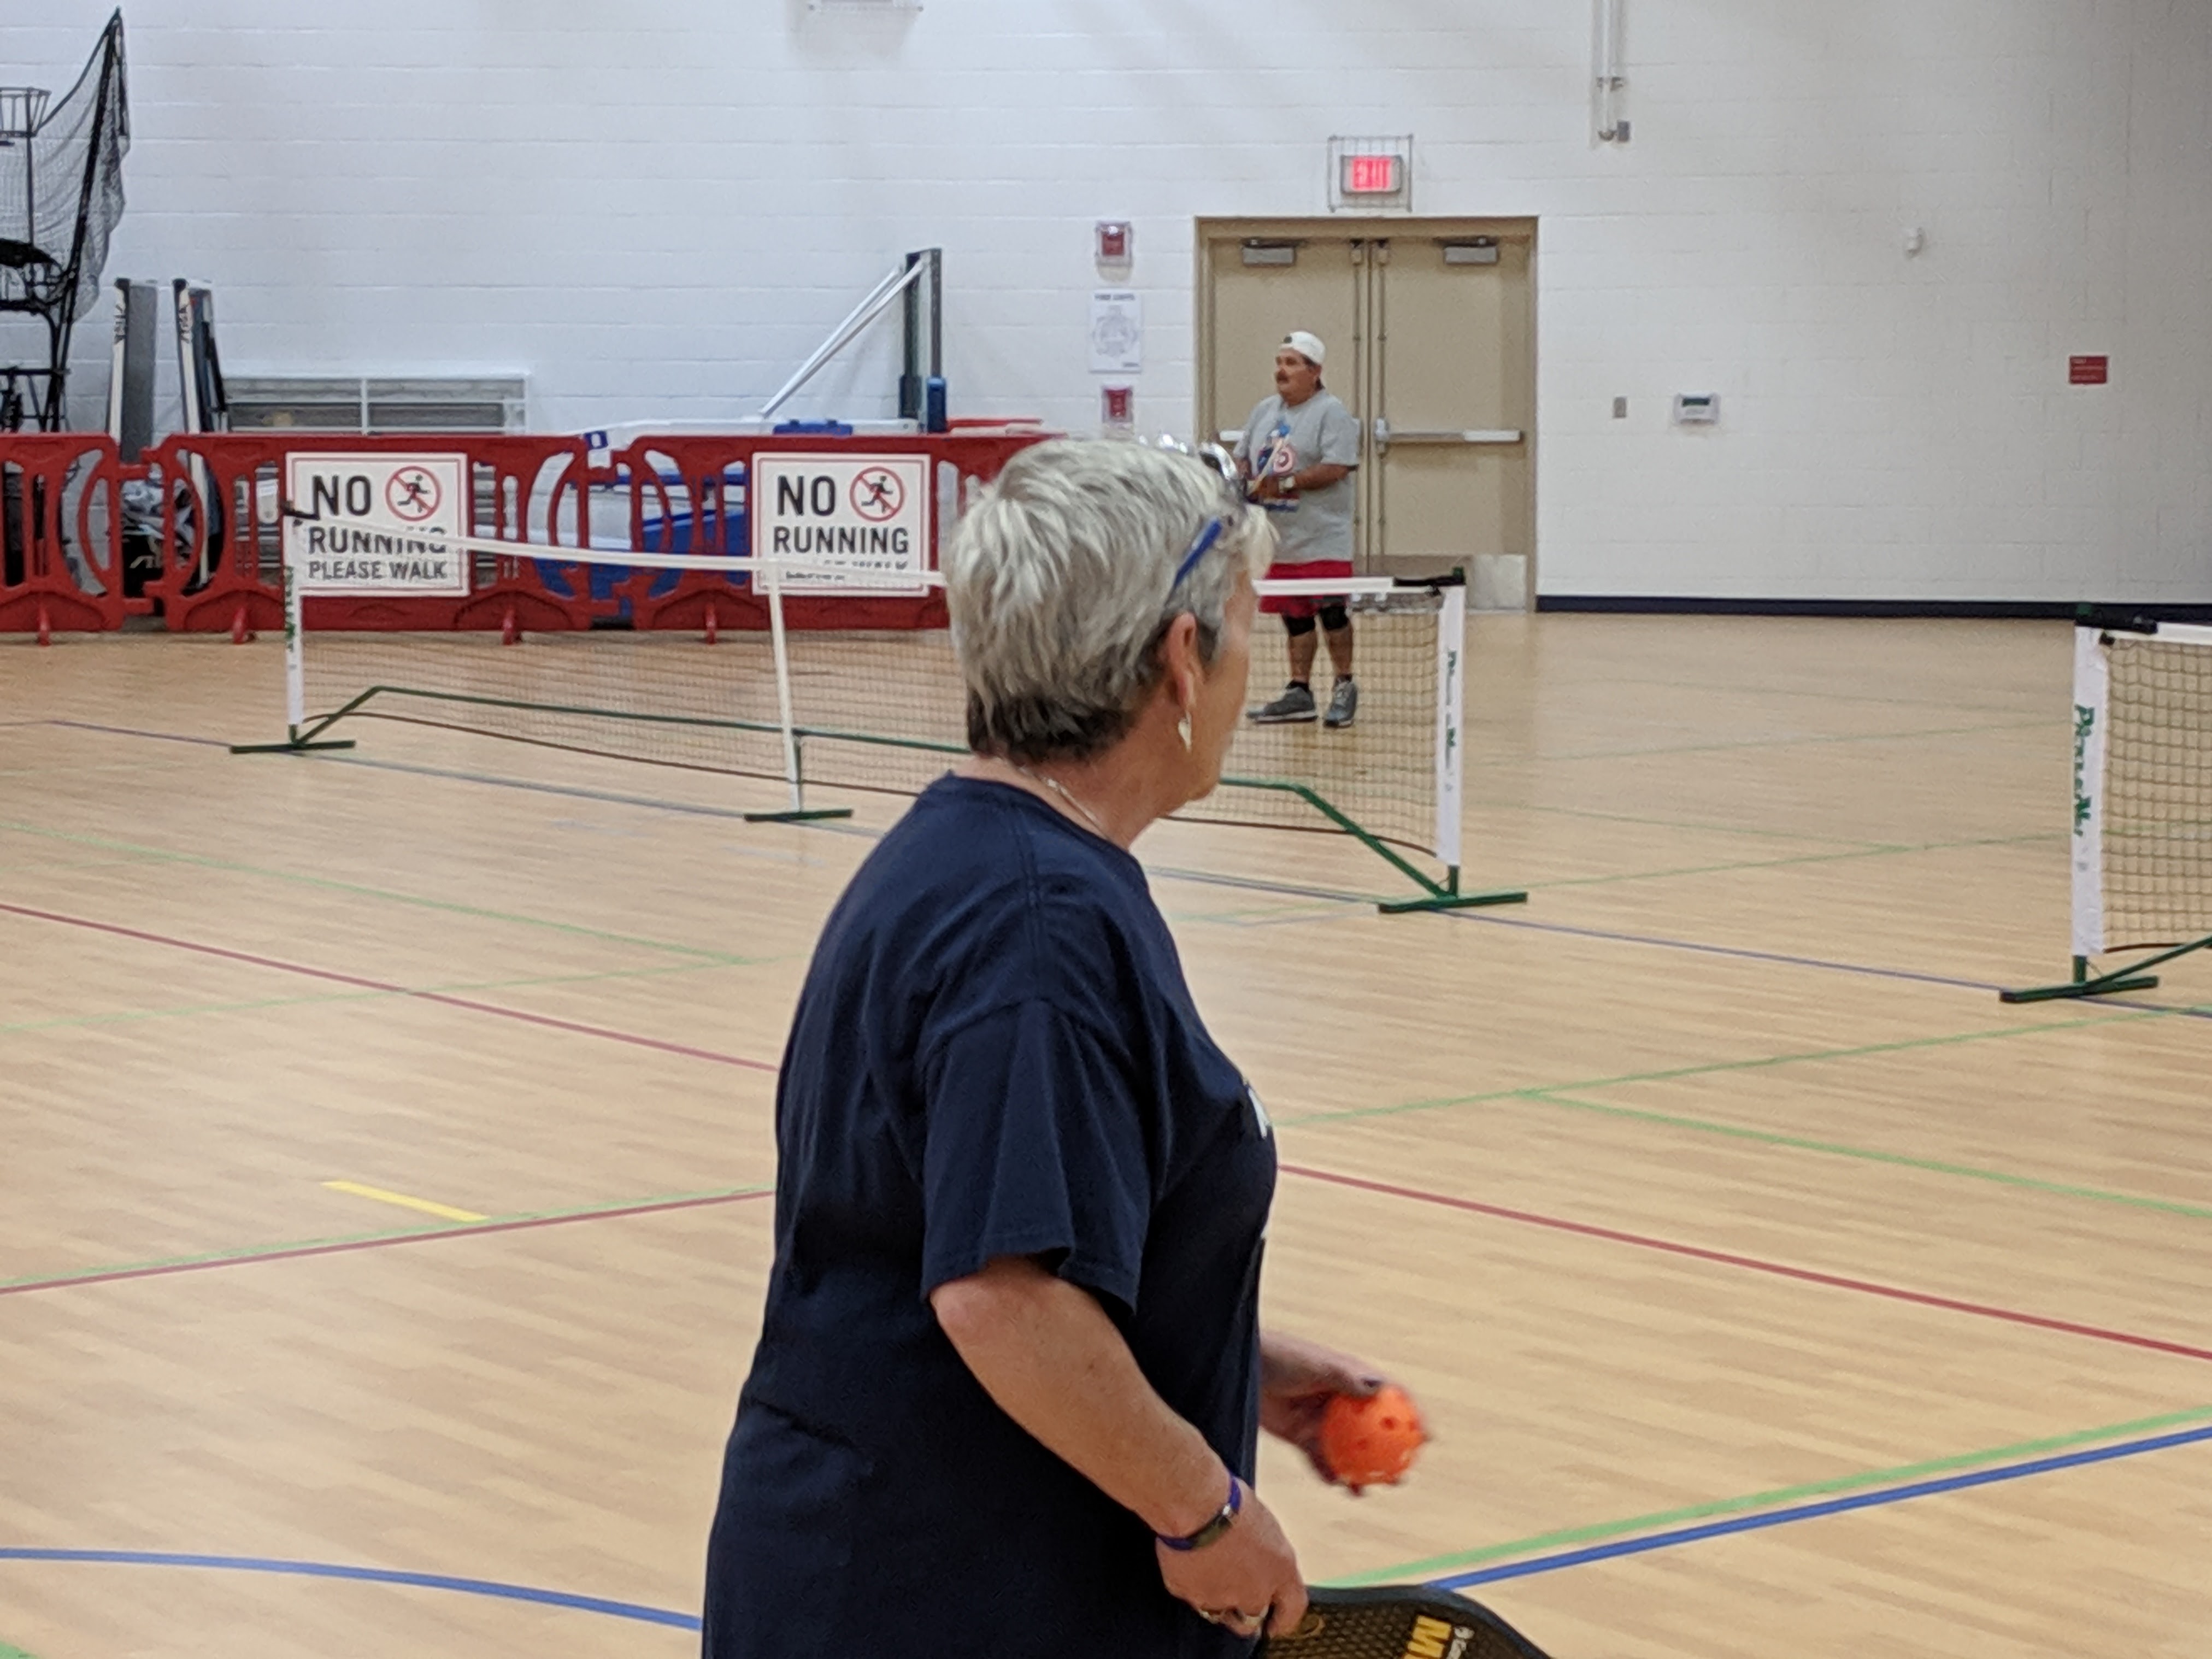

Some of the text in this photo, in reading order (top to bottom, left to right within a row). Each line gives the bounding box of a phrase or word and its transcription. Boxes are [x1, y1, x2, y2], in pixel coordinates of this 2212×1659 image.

[312, 474, 372, 516] NO
[776, 474, 837, 517] NO
[308, 526, 447, 555] RUNNING
[773, 525, 909, 555] RUNNING
[308, 560, 448, 580] PLEASE WALK
